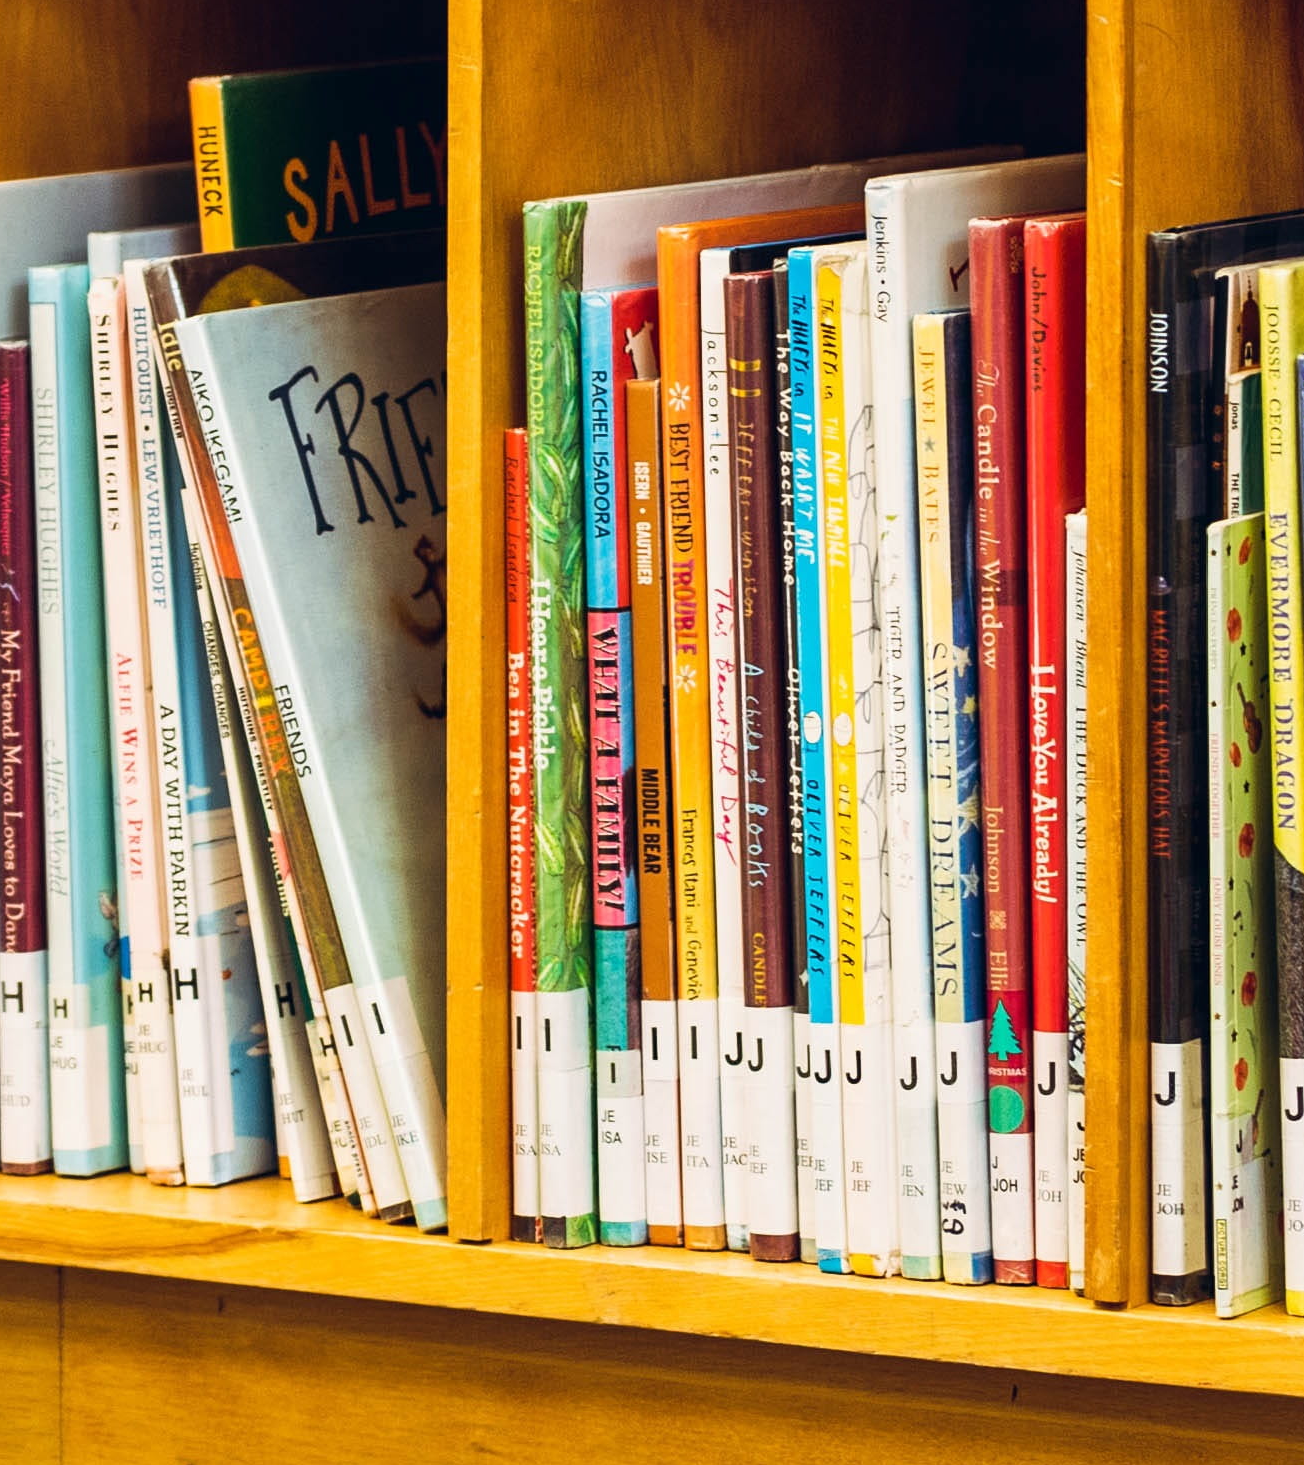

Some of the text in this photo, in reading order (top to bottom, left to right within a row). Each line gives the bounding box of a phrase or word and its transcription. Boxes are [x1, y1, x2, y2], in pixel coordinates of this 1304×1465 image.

[197, 125, 224, 218] HUNECK
[872, 214, 888, 323] Jenkins Gay
[187, 368, 313, 778] AIKO IKEGAMI FRIENDS
[668, 423, 699, 658] BEST FRIEND TROUBLE
[160, 705, 190, 937] A DAY WITH PARKIN
[640, 766, 661, 875] MIDDLE BEAR
[926, 642, 958, 999] SWEET DREAMS
[941, 1050, 958, 1086] J
[992, 1177, 1018, 1194] JOH
